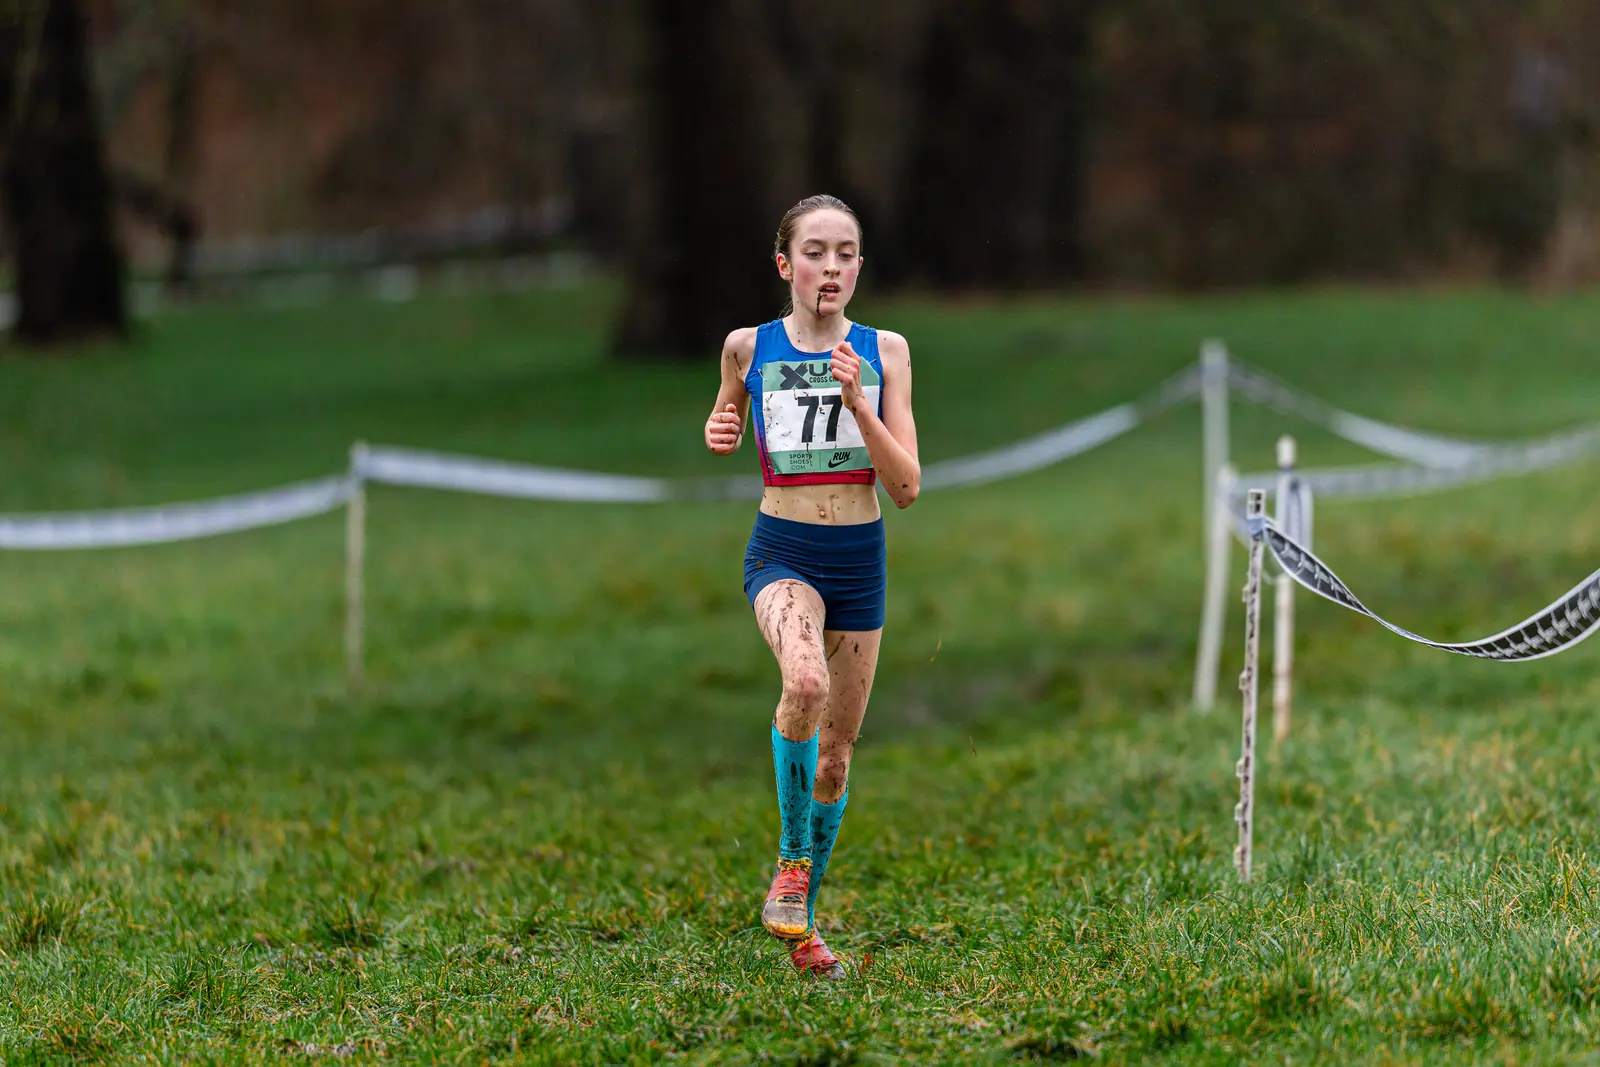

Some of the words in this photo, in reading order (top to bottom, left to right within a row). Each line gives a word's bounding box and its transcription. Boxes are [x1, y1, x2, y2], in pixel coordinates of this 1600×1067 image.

[808, 363, 832, 376] U
[797, 395, 843, 443] 77
[833, 451, 851, 461] RUN
